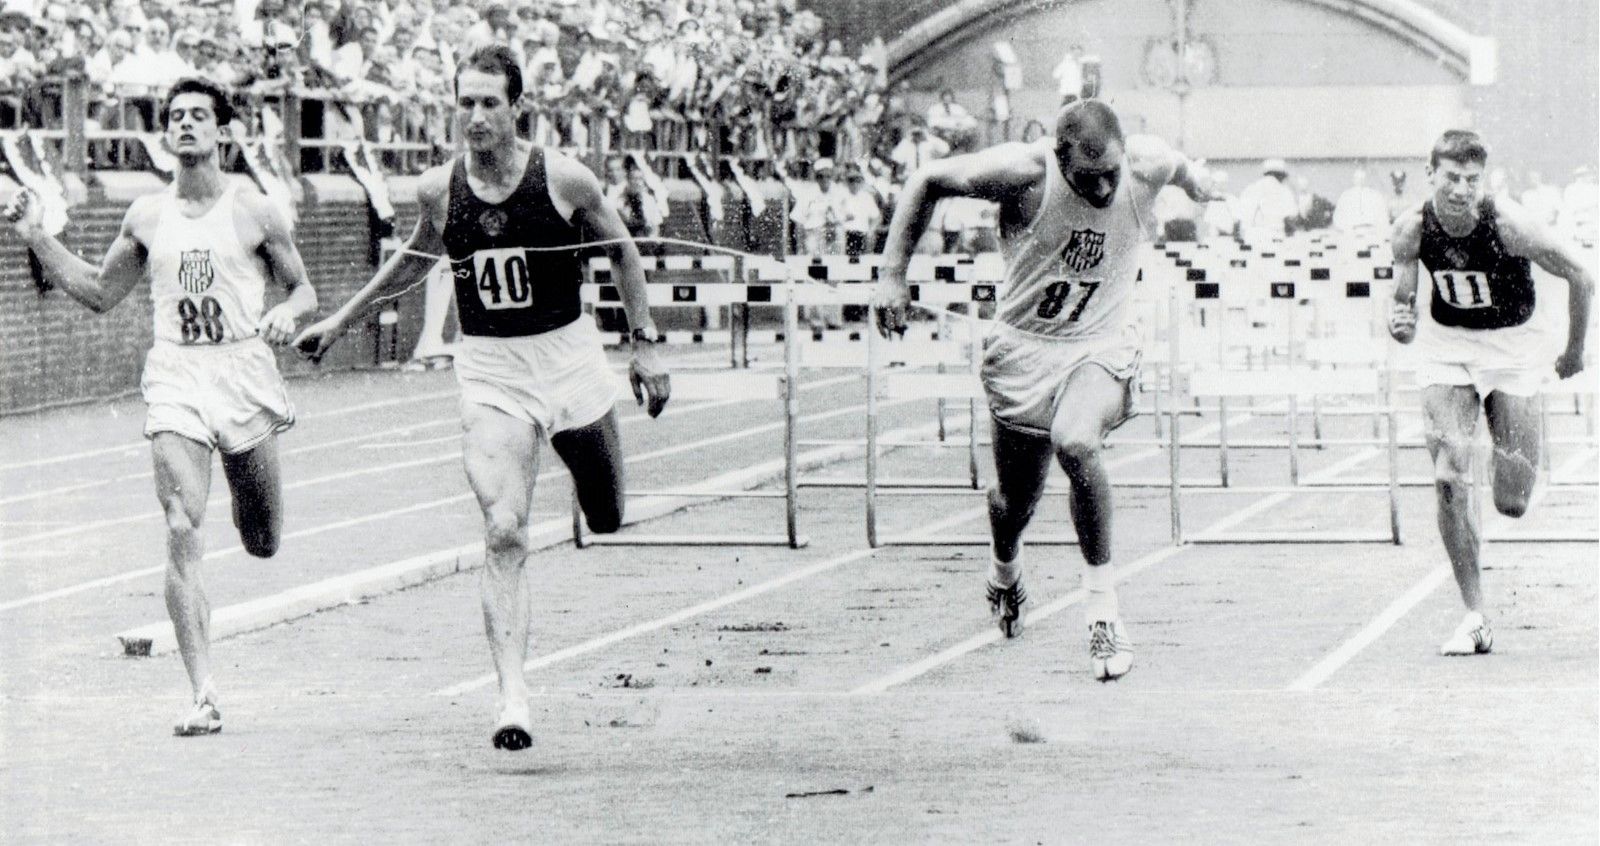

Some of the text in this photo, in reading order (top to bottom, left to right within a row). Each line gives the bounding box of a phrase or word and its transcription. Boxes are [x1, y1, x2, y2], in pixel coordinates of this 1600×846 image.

[479, 256, 529, 304] 40
[1037, 281, 1100, 322] 87
[1443, 273, 1484, 305] 11
[178, 296, 224, 343] 88
